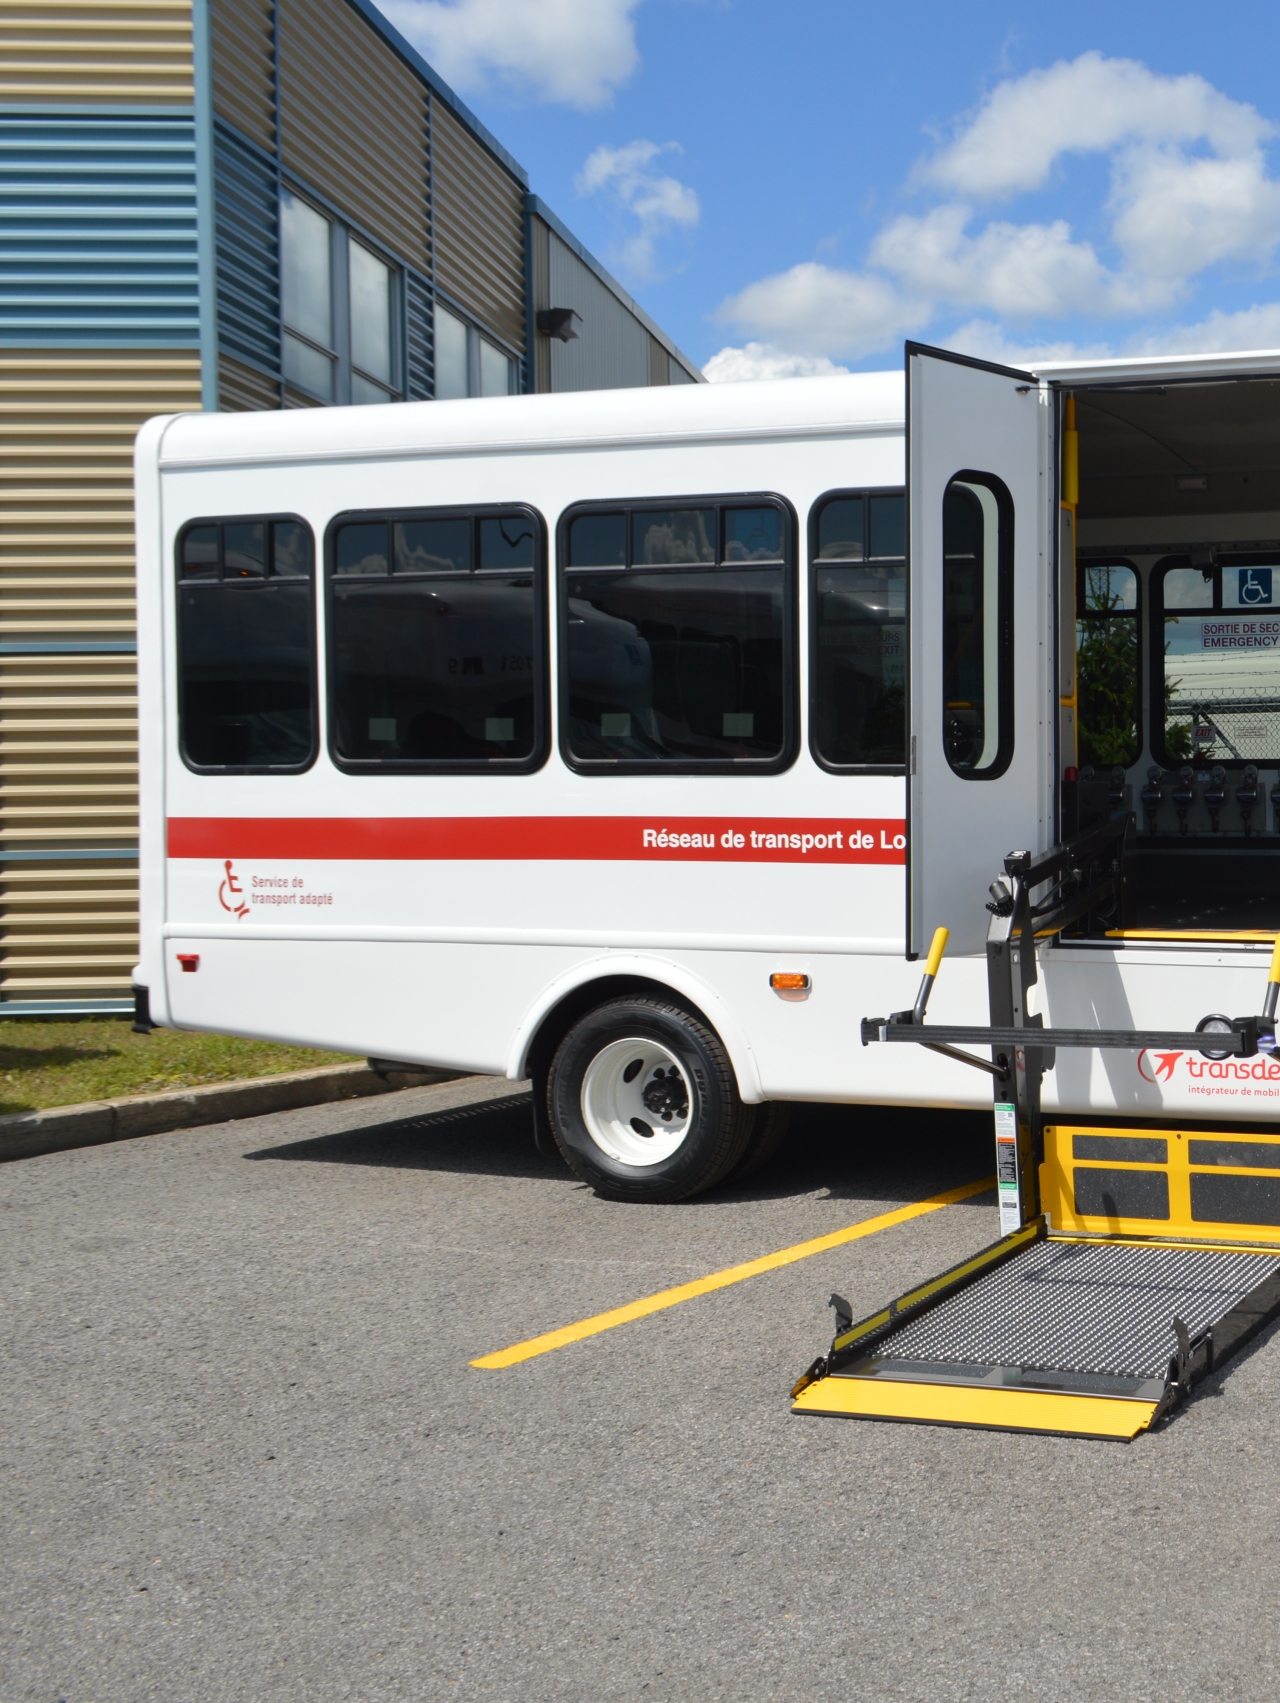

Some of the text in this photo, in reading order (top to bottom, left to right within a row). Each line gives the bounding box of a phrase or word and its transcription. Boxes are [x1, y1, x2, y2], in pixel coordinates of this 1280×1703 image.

[1203, 624, 1240, 635] SORTIE
[1243, 624, 1256, 634] DE
[1203, 636, 1279, 648] EMERGENCY
[878, 645, 901, 655] EXIT
[1195, 728, 1213, 737] EXIT
[643, 828, 715, 848] Réseau
[721, 829, 745, 848] de
[750, 830, 843, 853] transport
[848, 830, 874, 849] de
[252, 875, 304, 888] Service de
[252, 892, 333, 907] transport adapté
[1188, 1085, 1239, 1096] intégrateur
[1241, 1086, 1252, 1096] de
